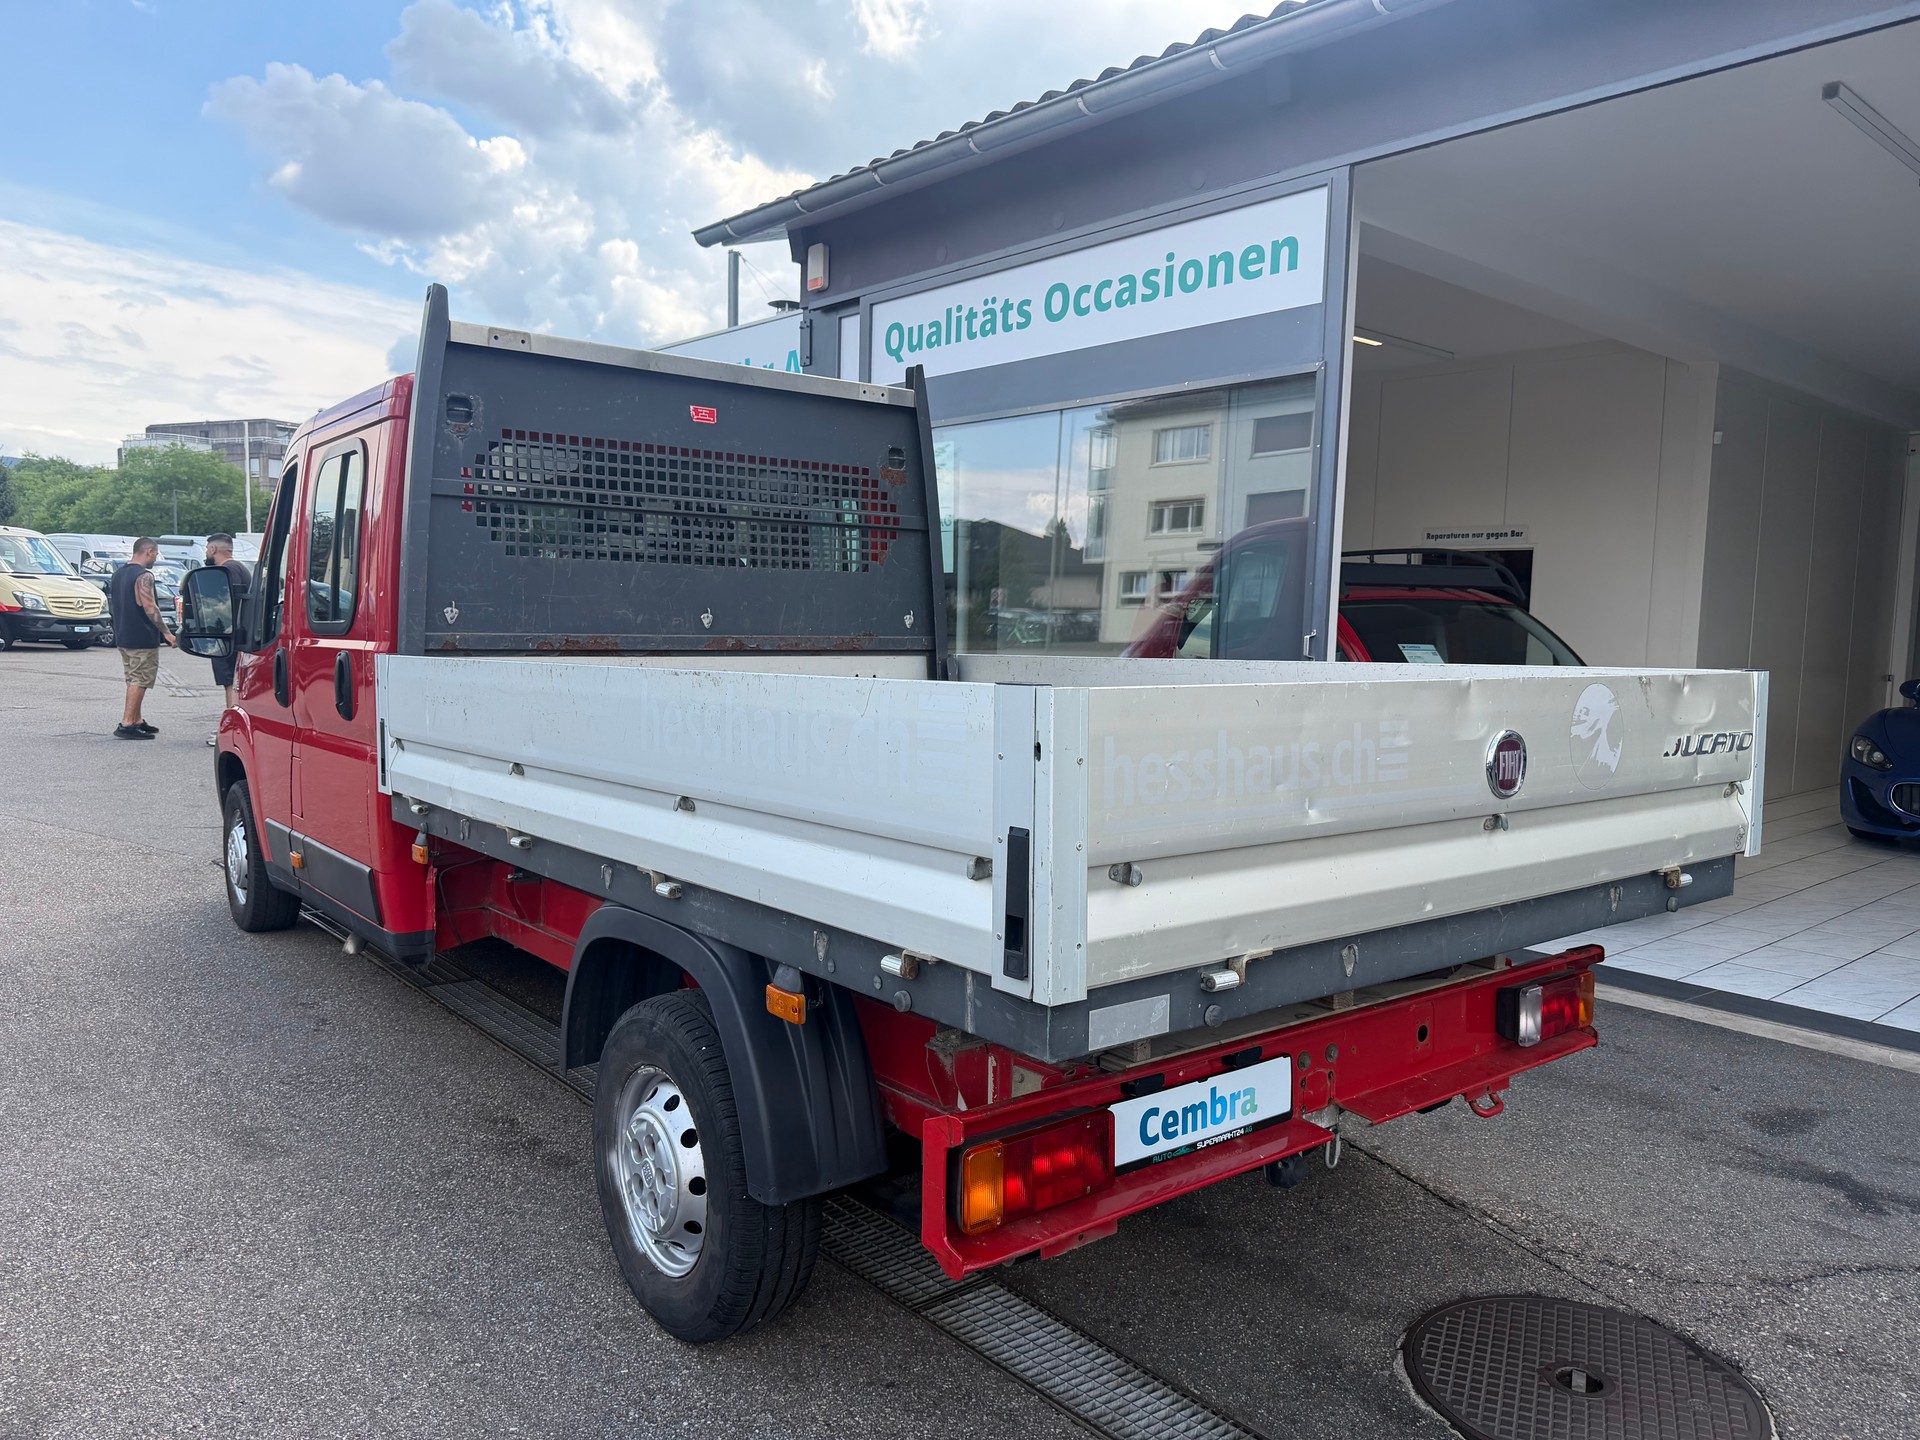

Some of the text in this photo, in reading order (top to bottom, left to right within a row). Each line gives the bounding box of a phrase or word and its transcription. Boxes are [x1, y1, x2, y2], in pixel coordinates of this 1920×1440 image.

[885, 235, 1299, 363] Qualitäts Occasionen
[1426, 532, 1470, 541] Reparaturen
[1486, 531, 1509, 540] gegen
[1511, 530, 1524, 538] Bar
[1104, 722, 1378, 808] hesshaus.ch
[1499, 750, 1521, 780] FIAT
[1139, 1086, 1258, 1146] Cembra
[1153, 1152, 1173, 1164] AUTO
[1245, 1126, 1253, 1135] AG
